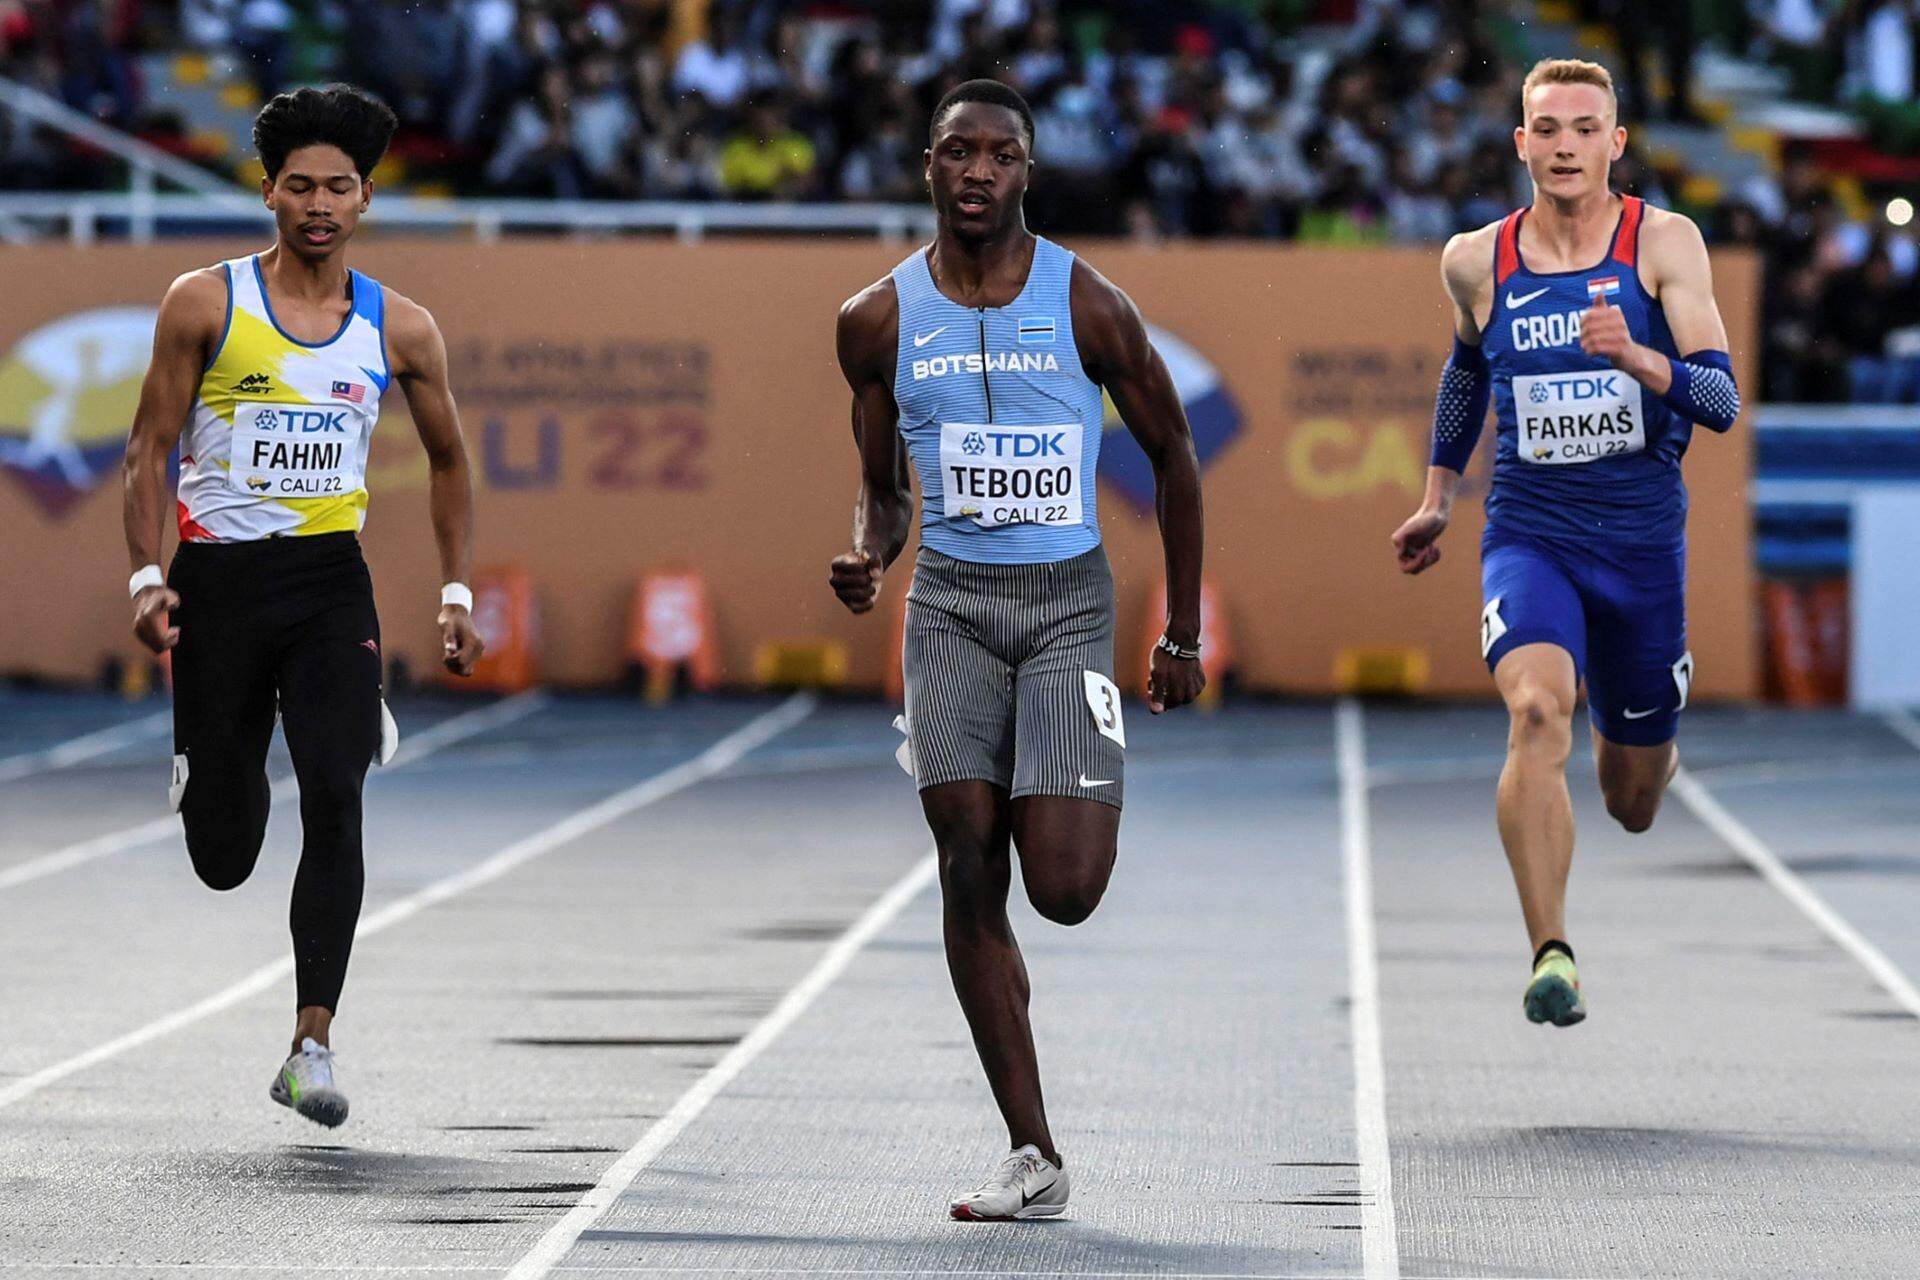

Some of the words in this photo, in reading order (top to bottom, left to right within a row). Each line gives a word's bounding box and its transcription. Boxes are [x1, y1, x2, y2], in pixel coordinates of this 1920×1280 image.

[1511, 304, 1620, 352] CROA
[912, 353, 1059, 380] BOTSWANA
[1549, 376, 1620, 401] TDK
[279, 410, 348, 432] TDK
[1526, 405, 1634, 440] FARKAŠ
[252, 440, 342, 470] FAHMI
[986, 432, 1066, 457] TDK
[1562, 443, 1600, 458] CALI
[1605, 440, 1628, 455] 22
[280, 478, 319, 492] CALI
[323, 476, 343, 492] 22
[950, 466, 1072, 498] TEBOGO
[993, 508, 1039, 523] CALI
[1044, 505, 1068, 522] 22
[1101, 685, 1116, 730] 3
